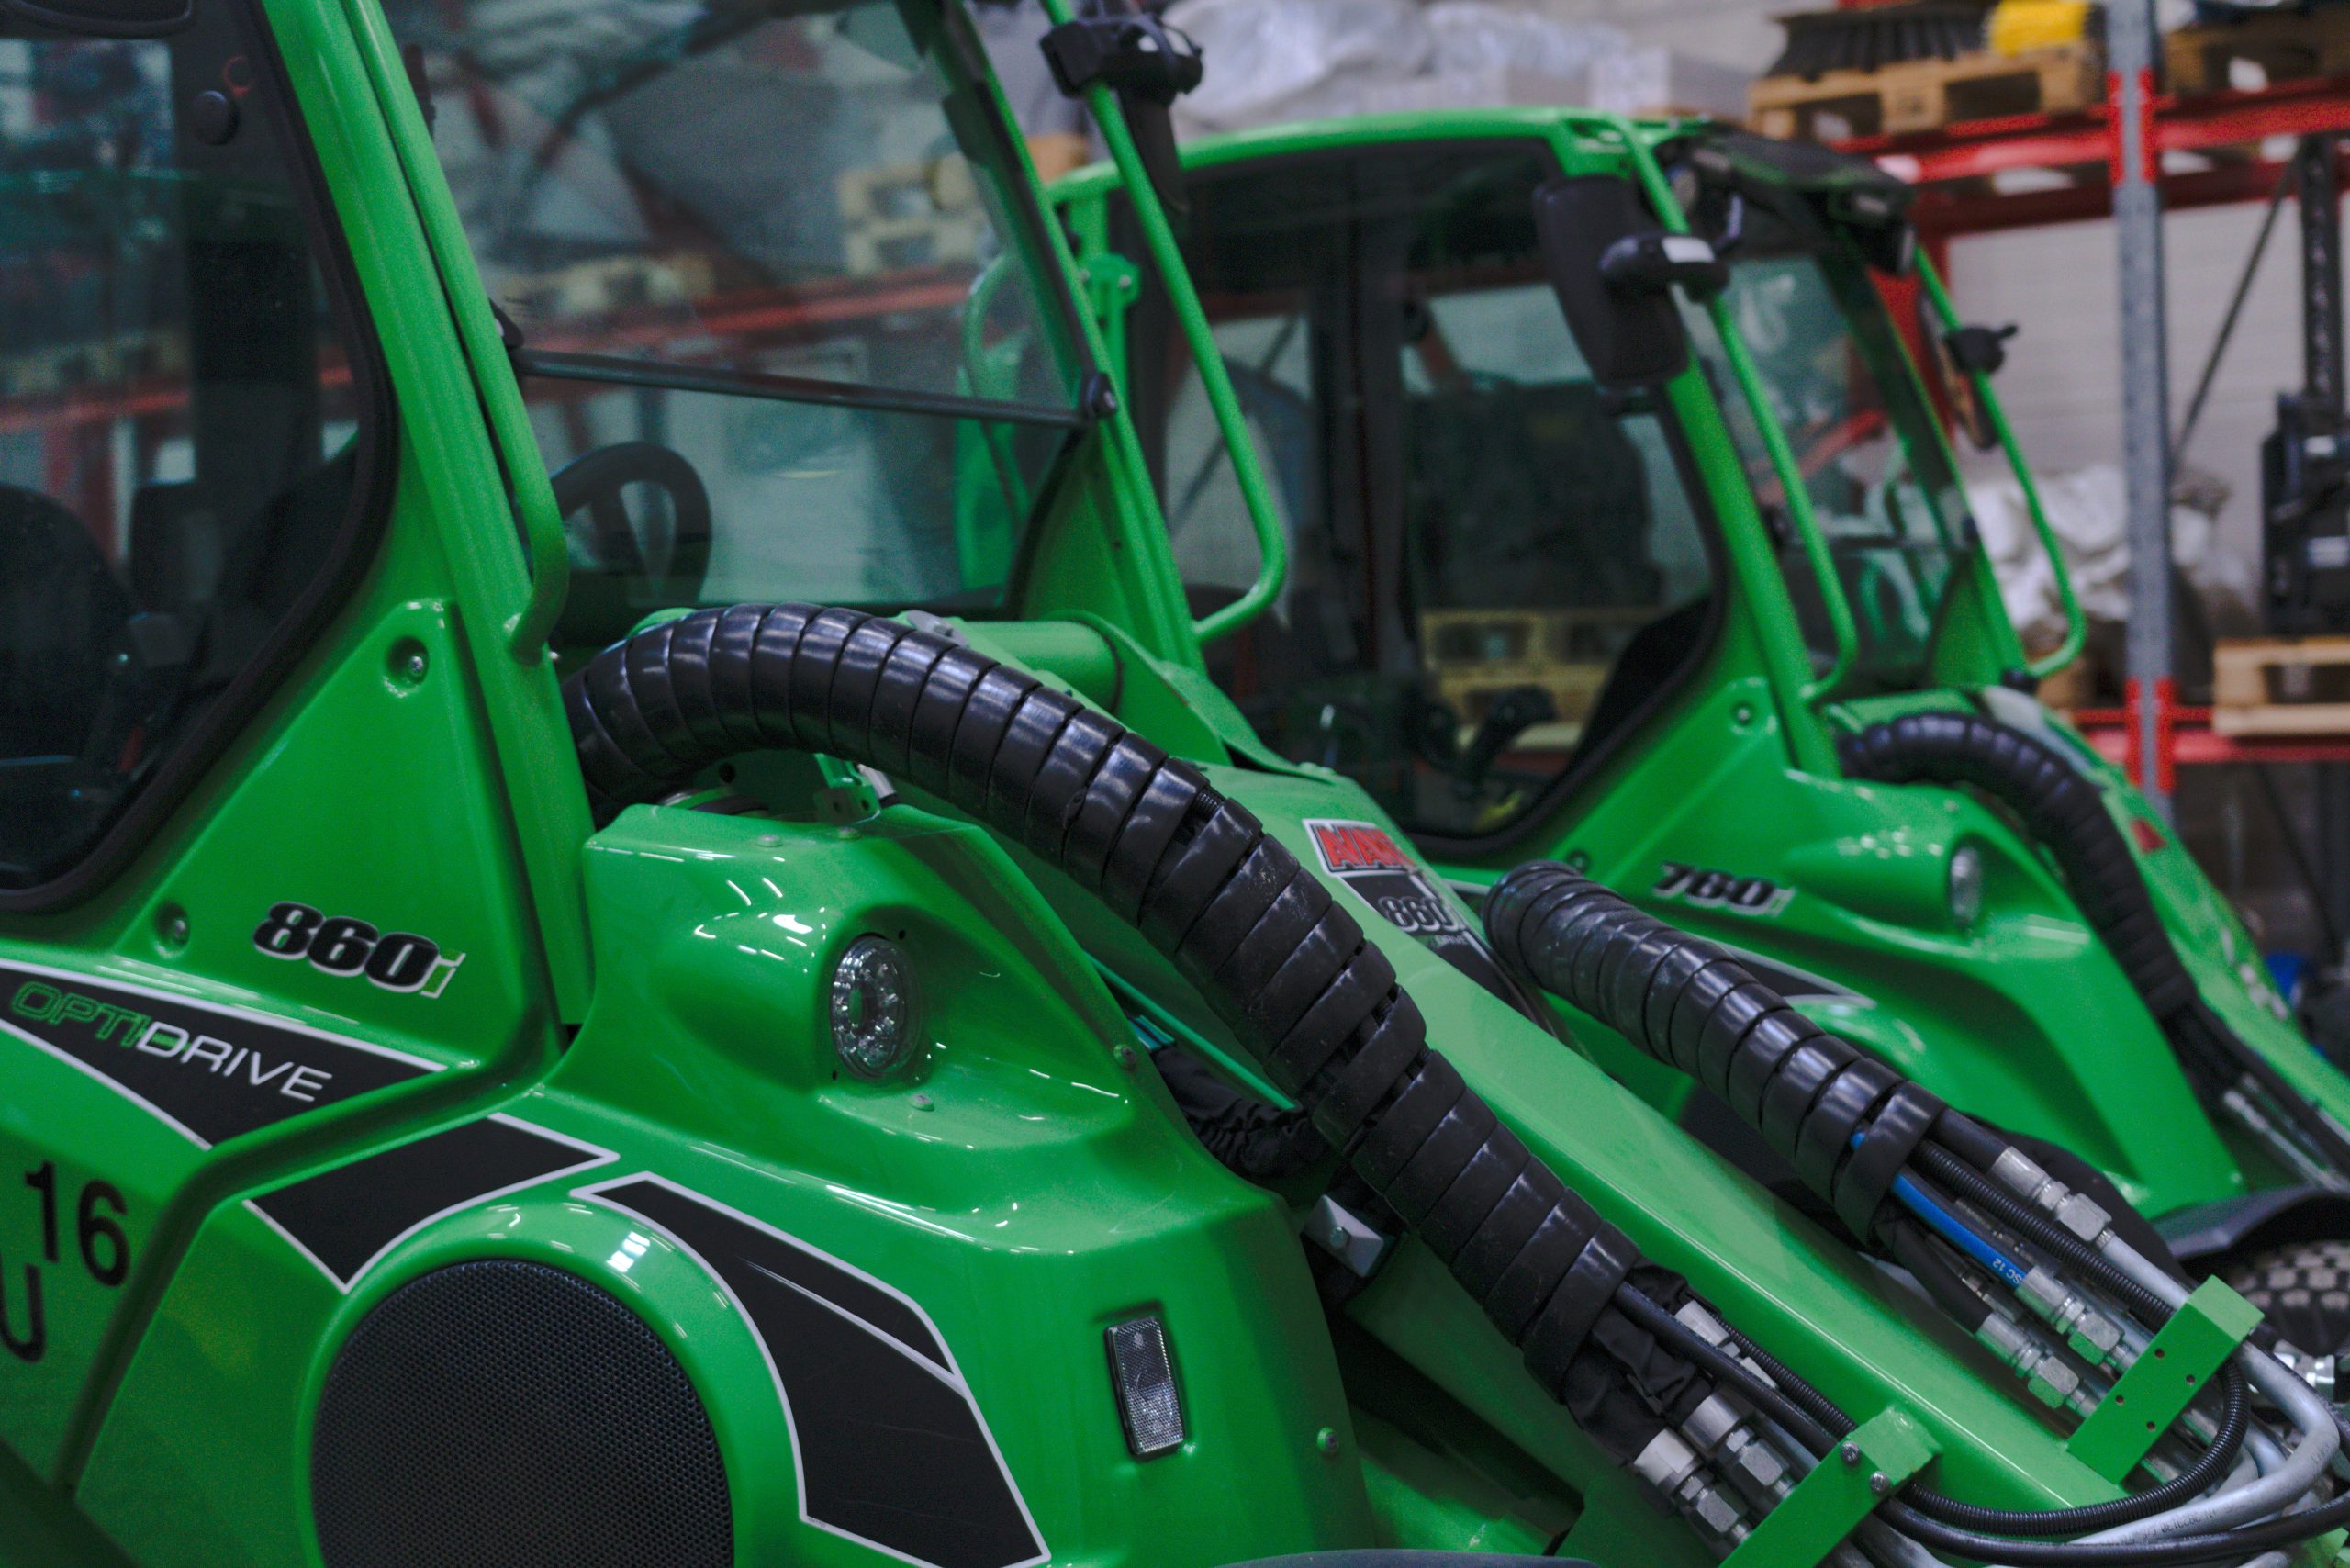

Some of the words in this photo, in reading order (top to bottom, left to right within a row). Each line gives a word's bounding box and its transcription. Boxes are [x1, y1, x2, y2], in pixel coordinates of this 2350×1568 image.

[252, 901, 466, 999] 860i
[10, 980, 333, 1103] OPTIDRIVE
[24, 1159, 130, 1288] 16
[1992, 1258, 2005, 1271] 12
